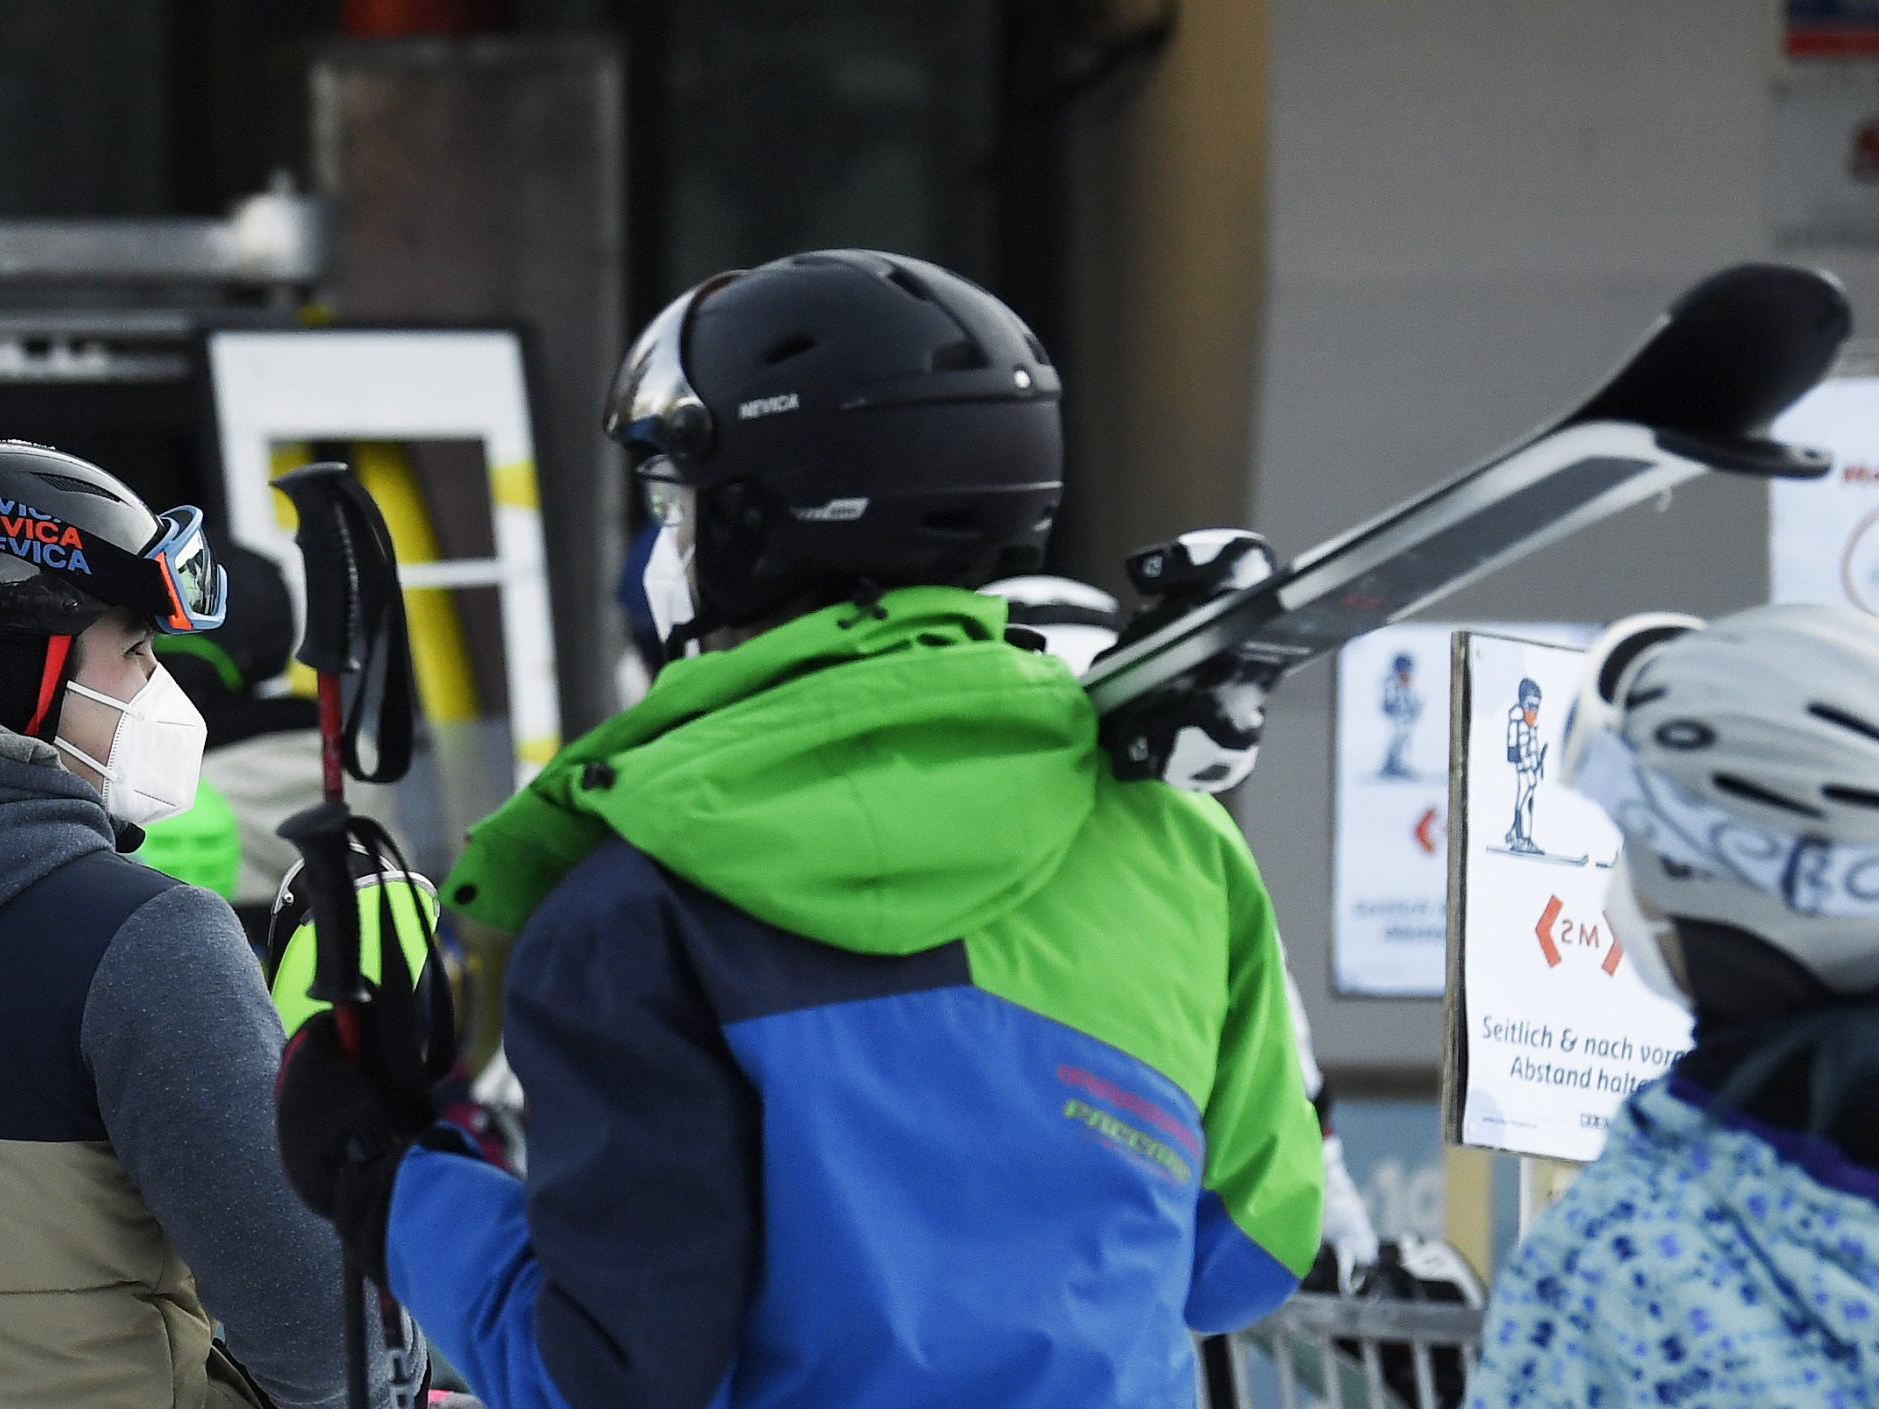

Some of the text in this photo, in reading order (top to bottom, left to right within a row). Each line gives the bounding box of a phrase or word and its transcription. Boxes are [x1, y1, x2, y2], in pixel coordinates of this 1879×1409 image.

[1561, 919, 1600, 948] 2M
[1482, 1014, 1553, 1050] Seitlich
[1560, 1028, 1579, 1052] &
[1584, 1037, 1633, 1061] nach
[1509, 1055, 1593, 1090] Abstand
